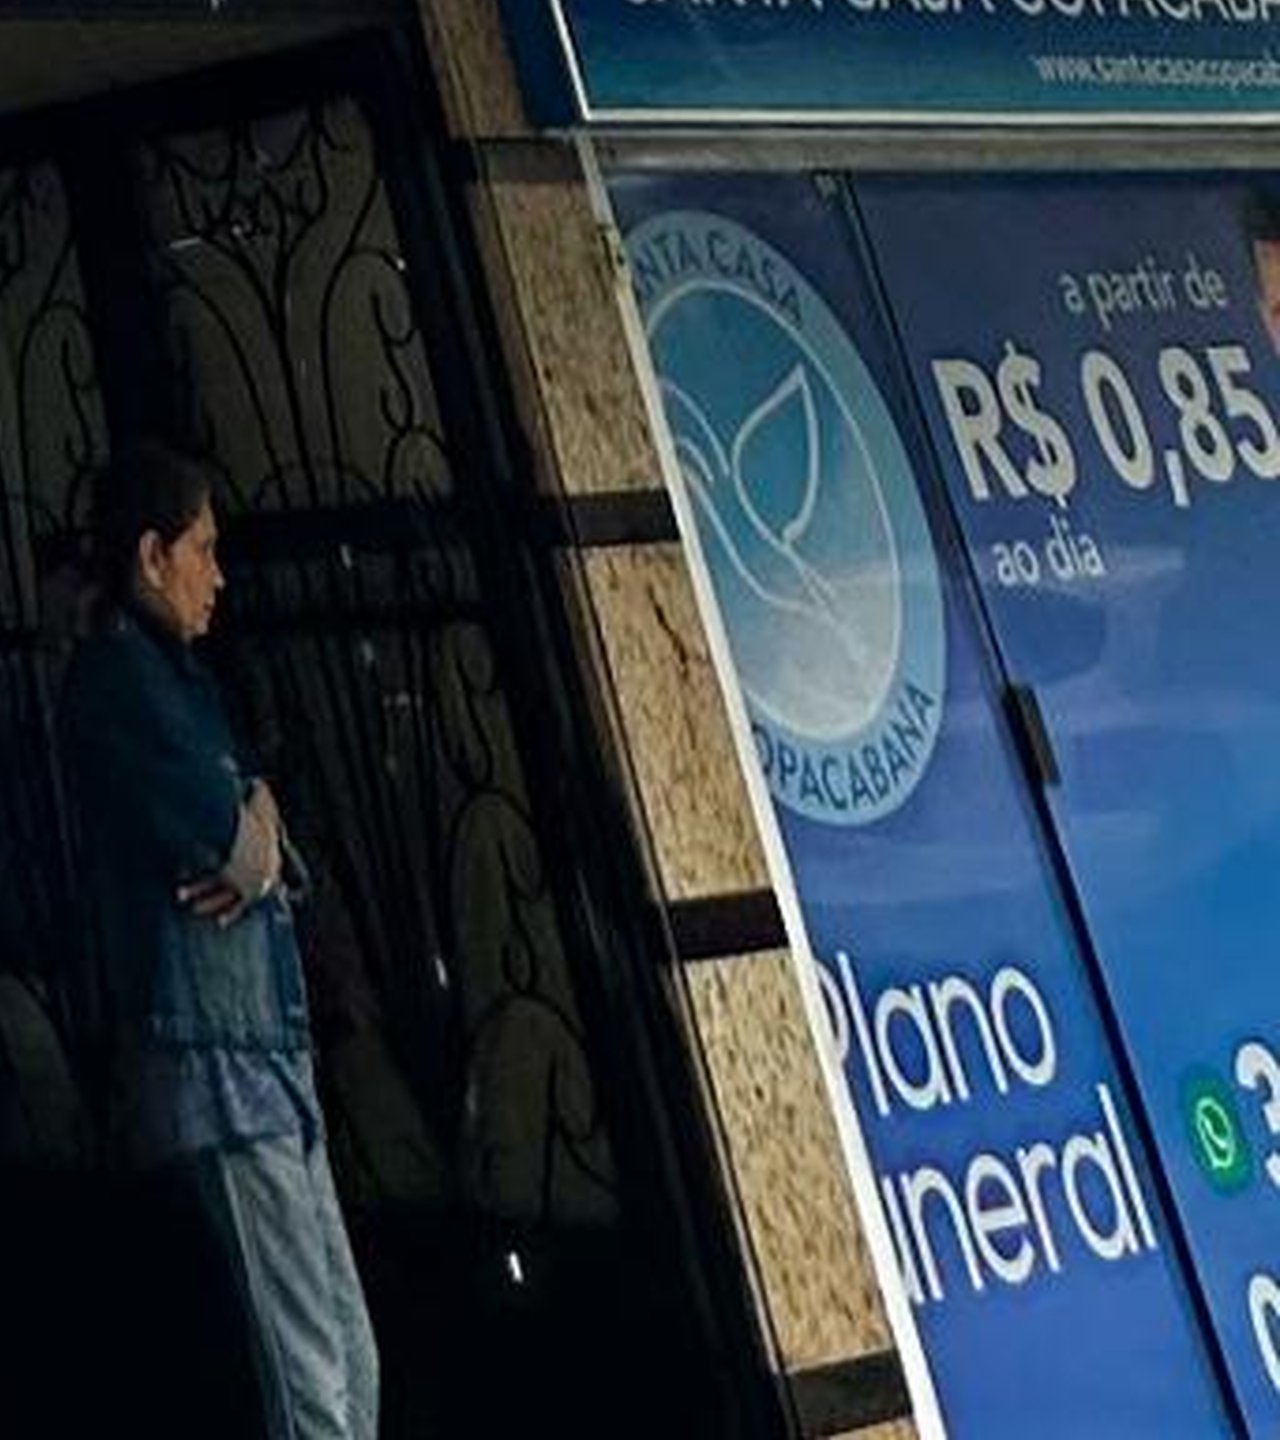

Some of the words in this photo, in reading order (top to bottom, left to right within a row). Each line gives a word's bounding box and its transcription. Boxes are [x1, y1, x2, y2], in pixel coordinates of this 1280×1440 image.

[1059, 274, 1085, 314] a
[1088, 255, 1178, 332] partir
[1185, 252, 1229, 309] de
[931, 338, 1077, 510] R$
[1081, 344, 1280, 509] 0,85
[992, 540, 1041, 586] ao
[1045, 513, 1107, 582] dia
[752, 681, 935, 811] OPACABANA
